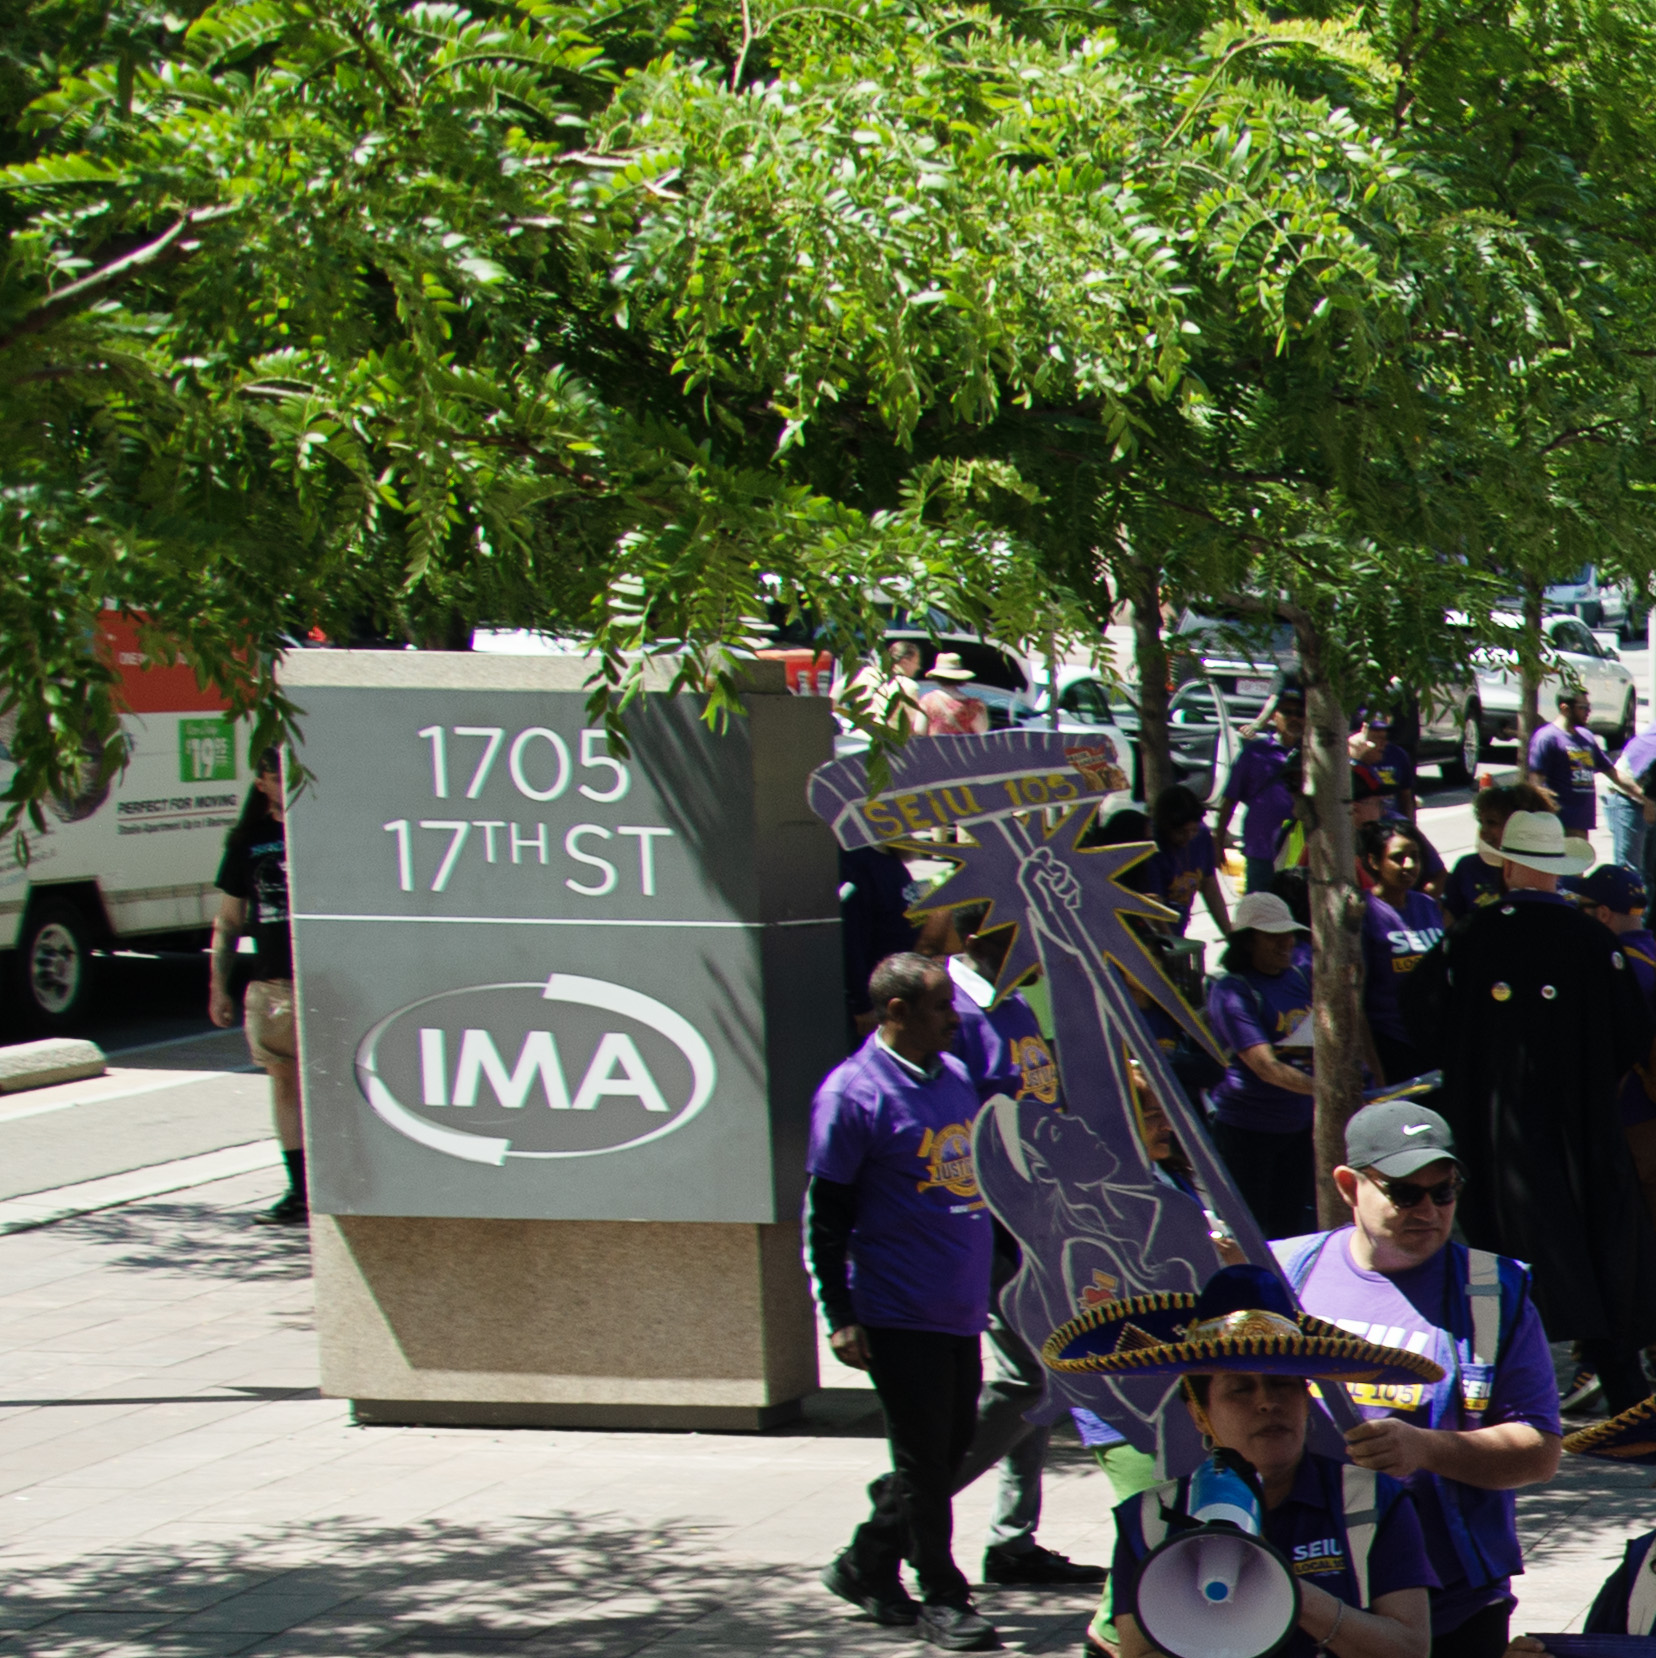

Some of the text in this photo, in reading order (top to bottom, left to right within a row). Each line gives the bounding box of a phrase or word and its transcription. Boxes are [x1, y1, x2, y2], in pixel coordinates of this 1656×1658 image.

[418, 725, 630, 803] 1705
[1003, 774, 1079, 807] 105
[565, 825, 674, 896] ST
[419, 1029, 670, 1112] IMA
[1372, 1383, 1416, 1405] 105
[1293, 1538, 1343, 1561] SEIU
